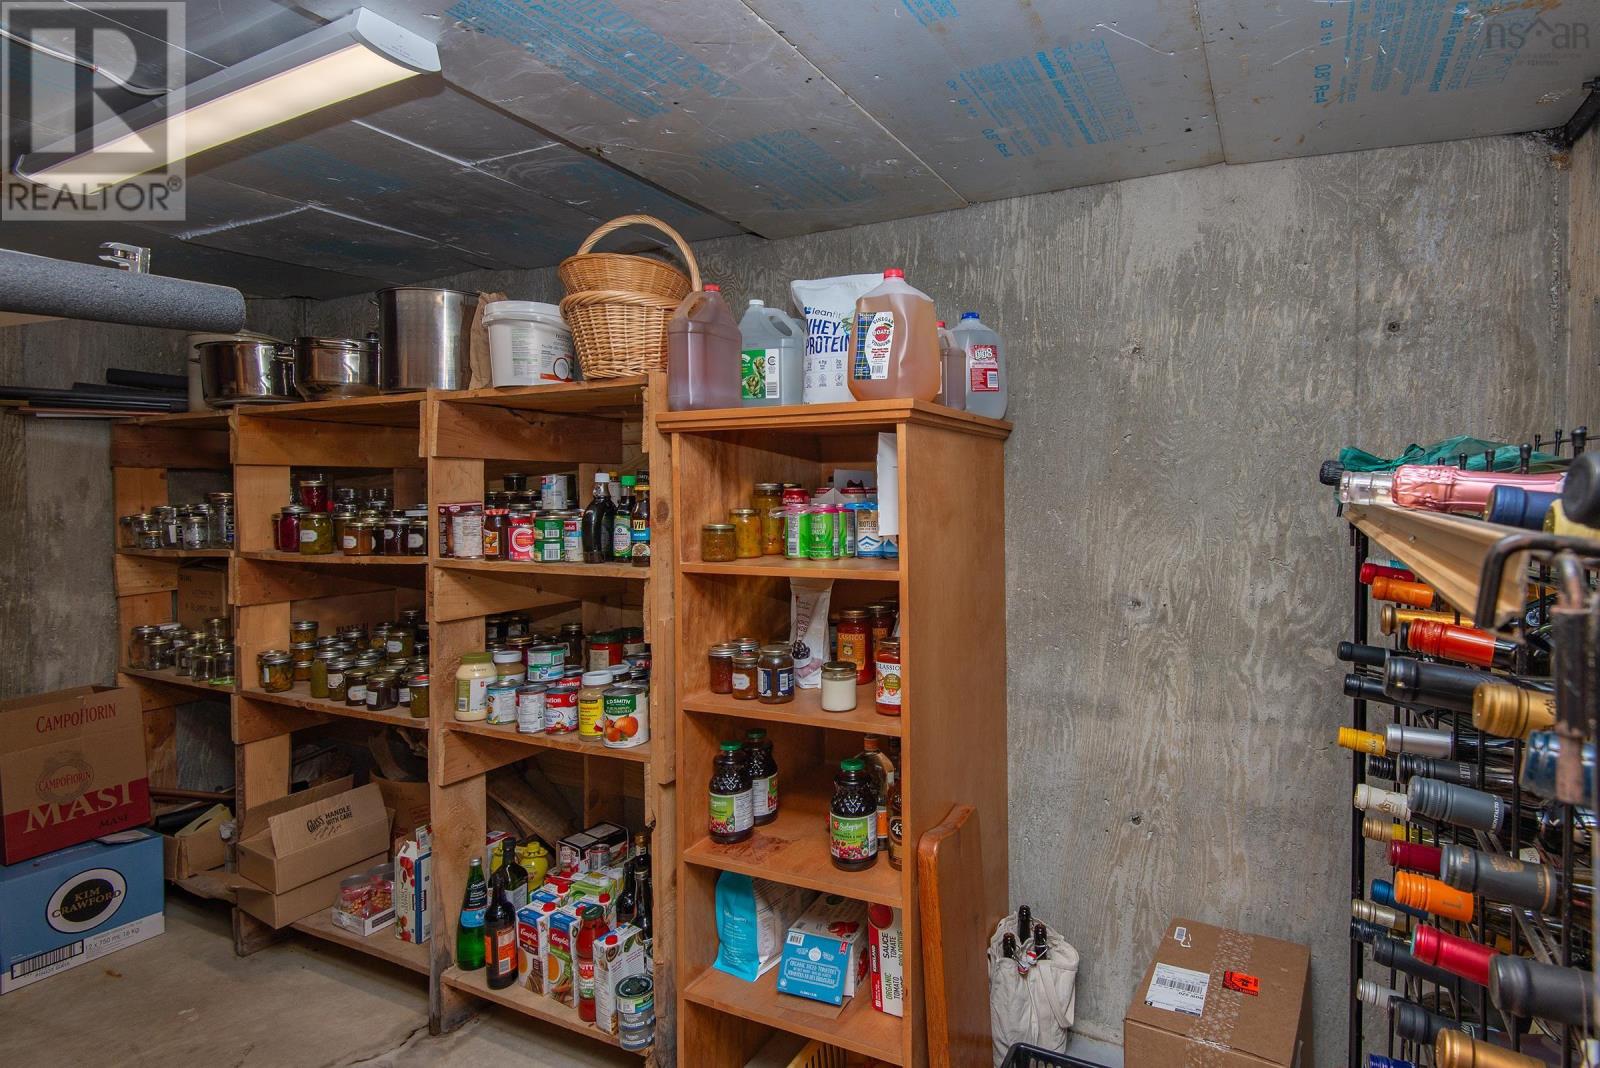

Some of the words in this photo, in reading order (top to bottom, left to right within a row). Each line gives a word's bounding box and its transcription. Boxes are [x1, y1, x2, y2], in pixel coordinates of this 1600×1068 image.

[23, 783, 135, 834] MASI
[325, 805, 351, 819] HANDLE
[51, 888, 122, 919] CRAWFORD
[74, 886, 101, 902] KIM
[881, 932, 889, 960] SAUCE
[889, 935, 897, 960] TOMATE
[884, 972, 893, 1000] ORGANIC
[893, 976, 901, 1000] TOMATO
